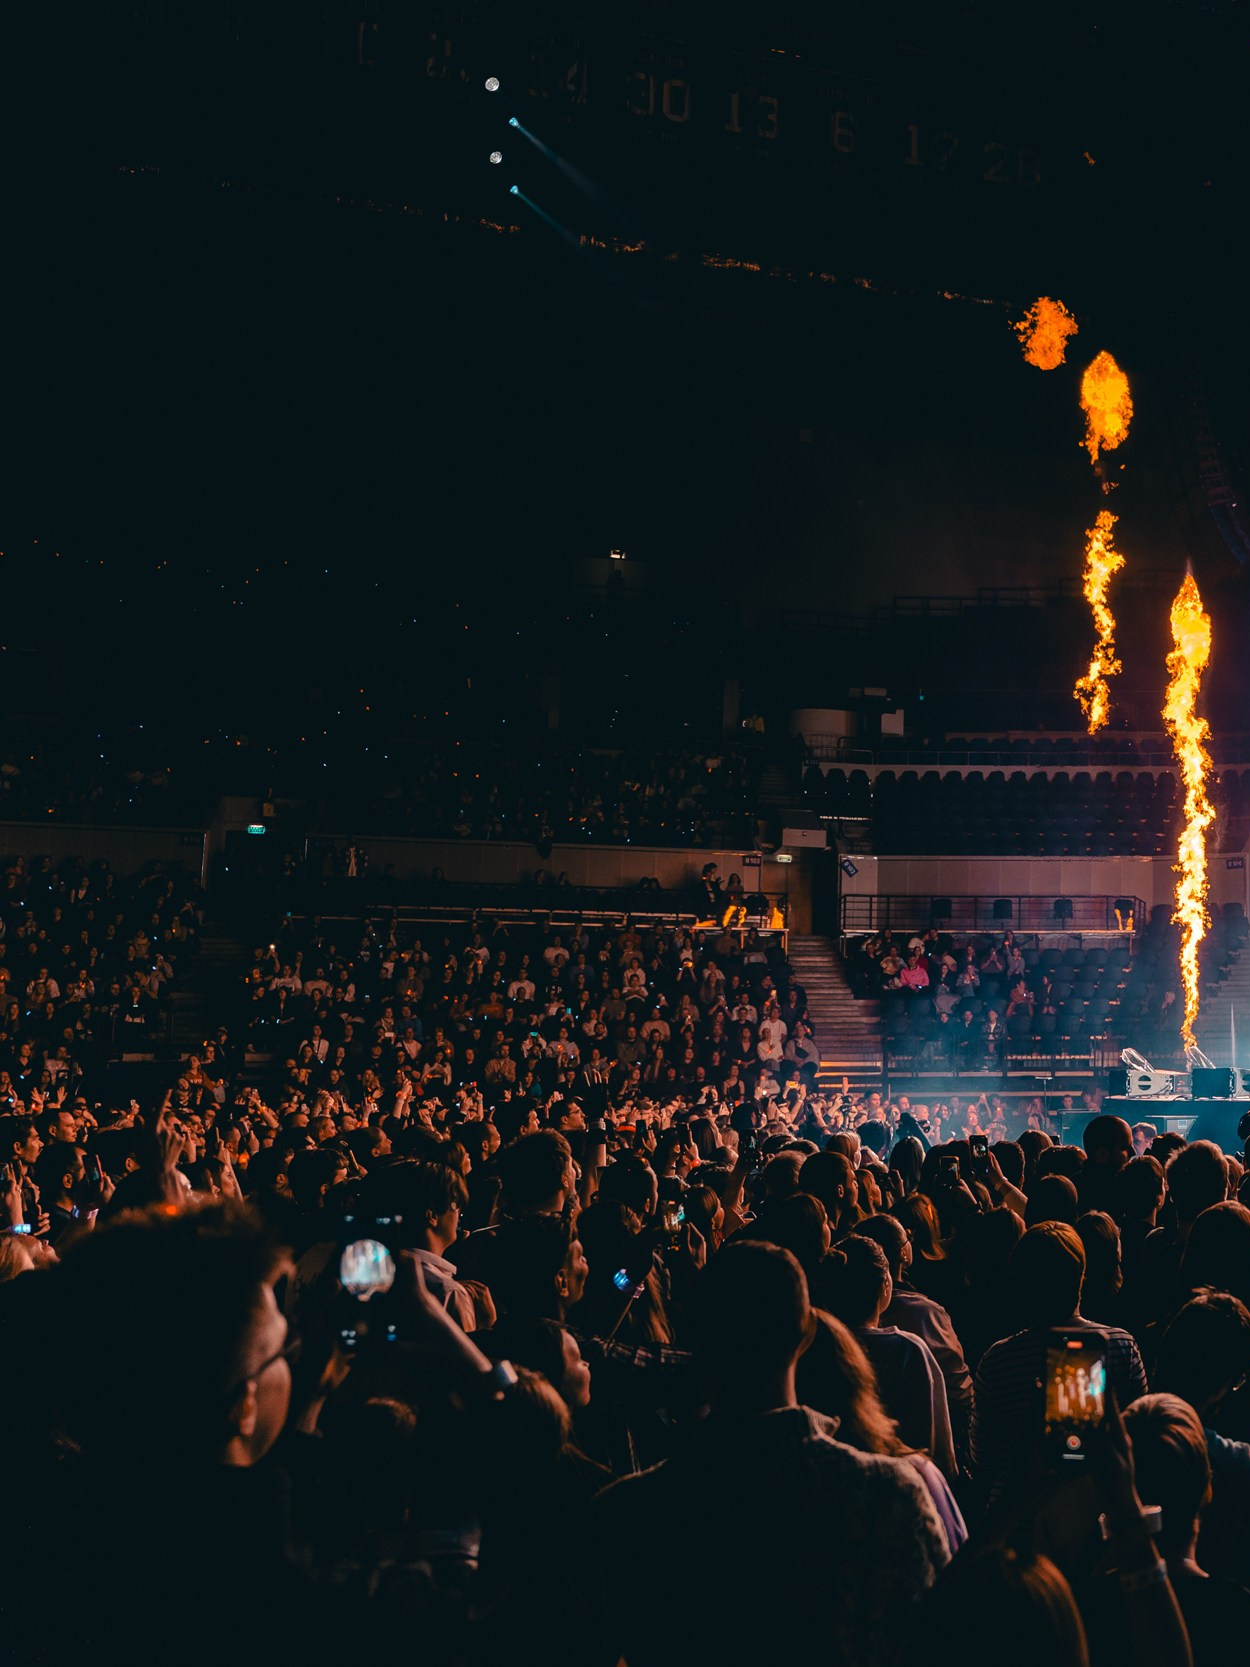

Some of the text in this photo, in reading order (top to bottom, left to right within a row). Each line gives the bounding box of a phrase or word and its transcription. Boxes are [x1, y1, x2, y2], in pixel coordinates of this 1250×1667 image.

[624, 70, 690, 123] 30
[723, 90, 781, 140] 13
[831, 109, 858, 154] 6
